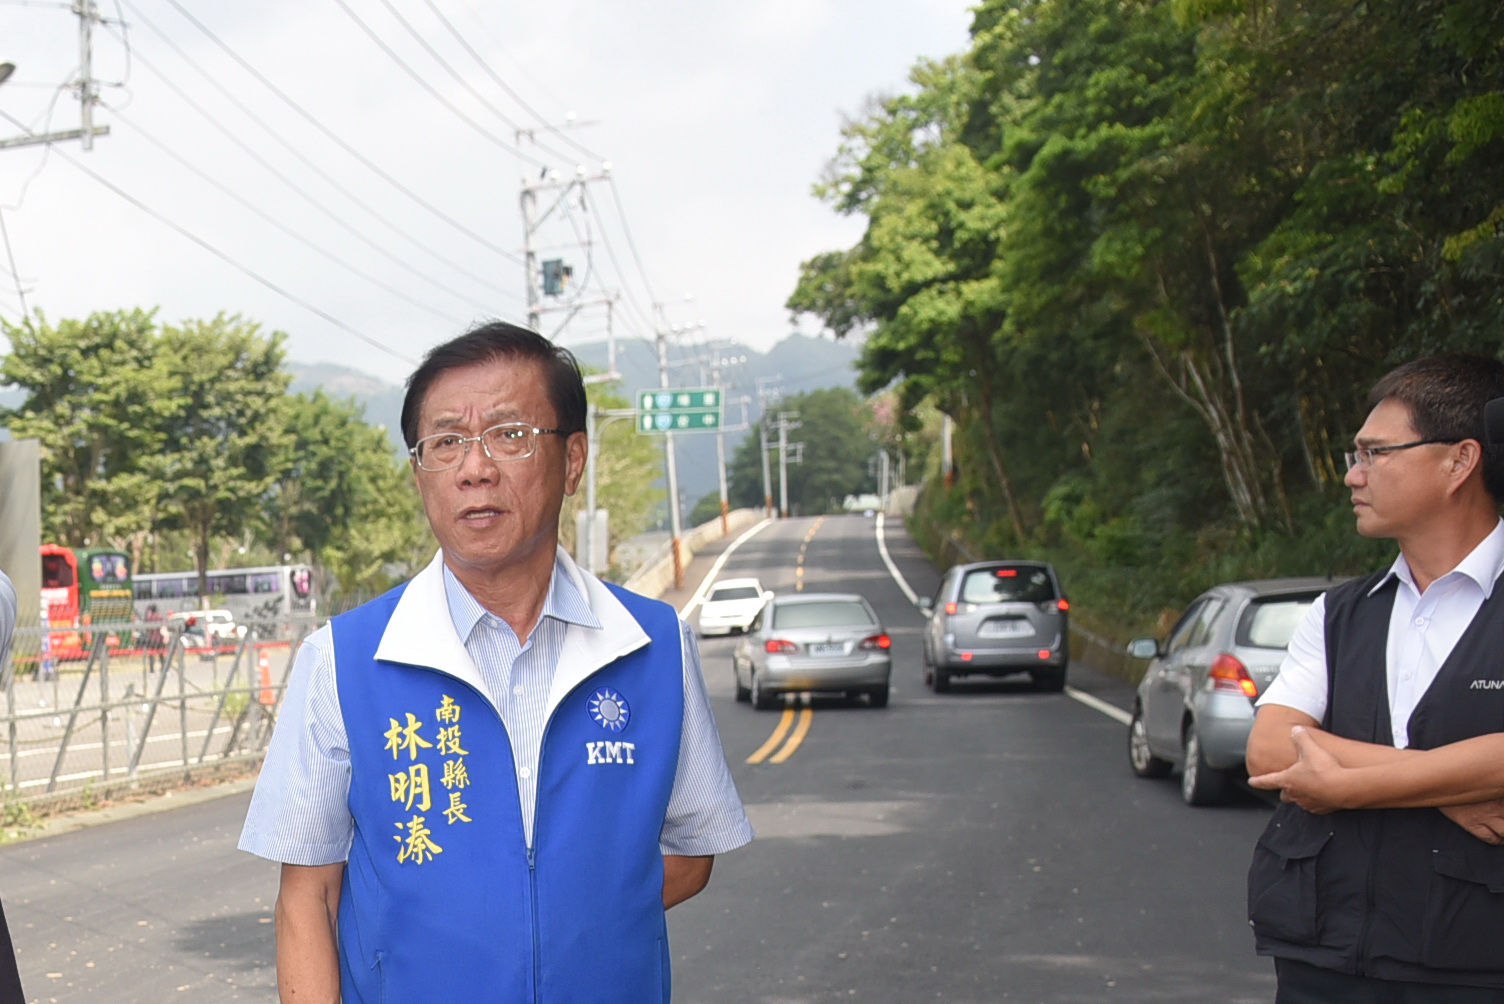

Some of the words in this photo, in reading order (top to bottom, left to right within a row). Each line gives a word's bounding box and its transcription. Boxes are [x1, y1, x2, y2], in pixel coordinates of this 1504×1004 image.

[383, 712, 444, 866] 林明溱
[435, 694, 473, 825] 南投縣長
[586, 740, 636, 765] KMT
